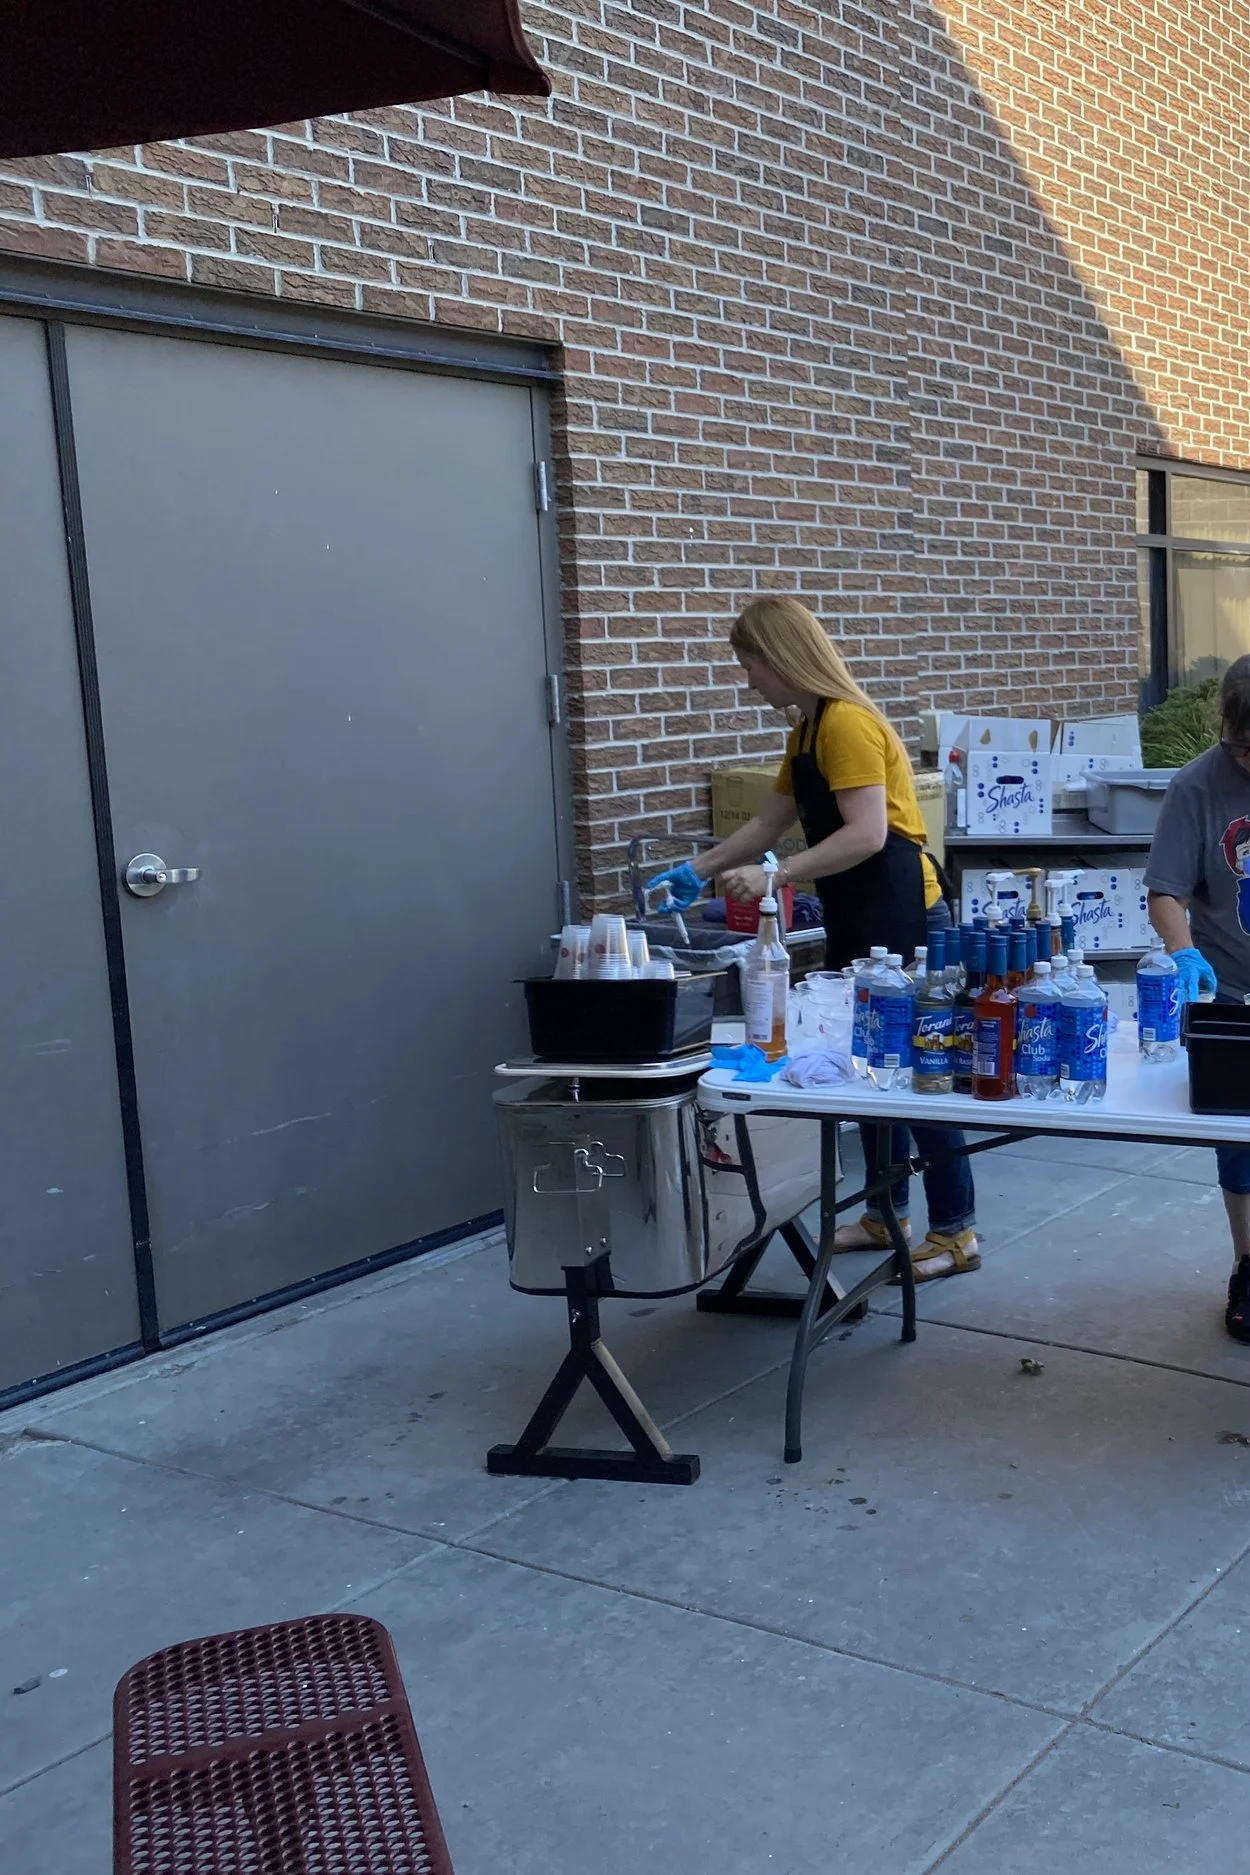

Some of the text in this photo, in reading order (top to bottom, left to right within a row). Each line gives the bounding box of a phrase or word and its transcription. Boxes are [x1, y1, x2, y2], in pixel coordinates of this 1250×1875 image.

[986, 783, 1034, 813] Shasta
[915, 1012, 953, 1036] Torani
[1018, 1017, 1054, 1043] hasta
[920, 1056, 949, 1065] VANILLA
[1021, 1043, 1046, 1055] Club
